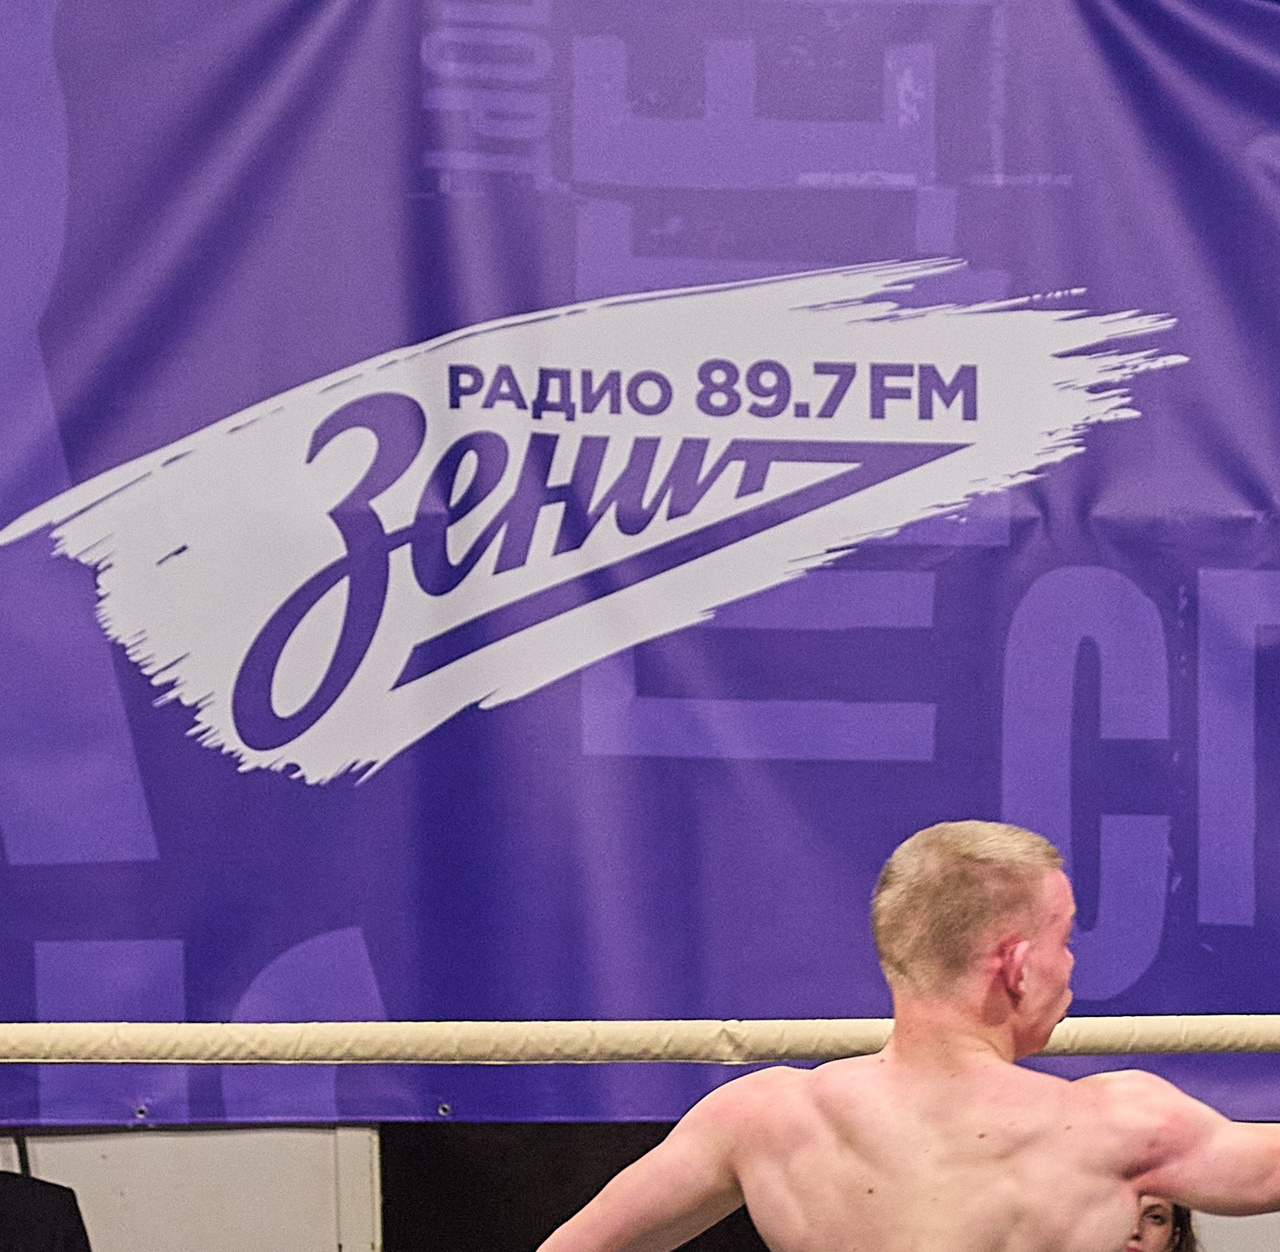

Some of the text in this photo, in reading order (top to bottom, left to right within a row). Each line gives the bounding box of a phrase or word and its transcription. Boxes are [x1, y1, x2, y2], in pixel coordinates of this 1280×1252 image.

[448, 358, 977, 421] РАДИО 89.7 FM
[232, 391, 940, 751] Зенит
